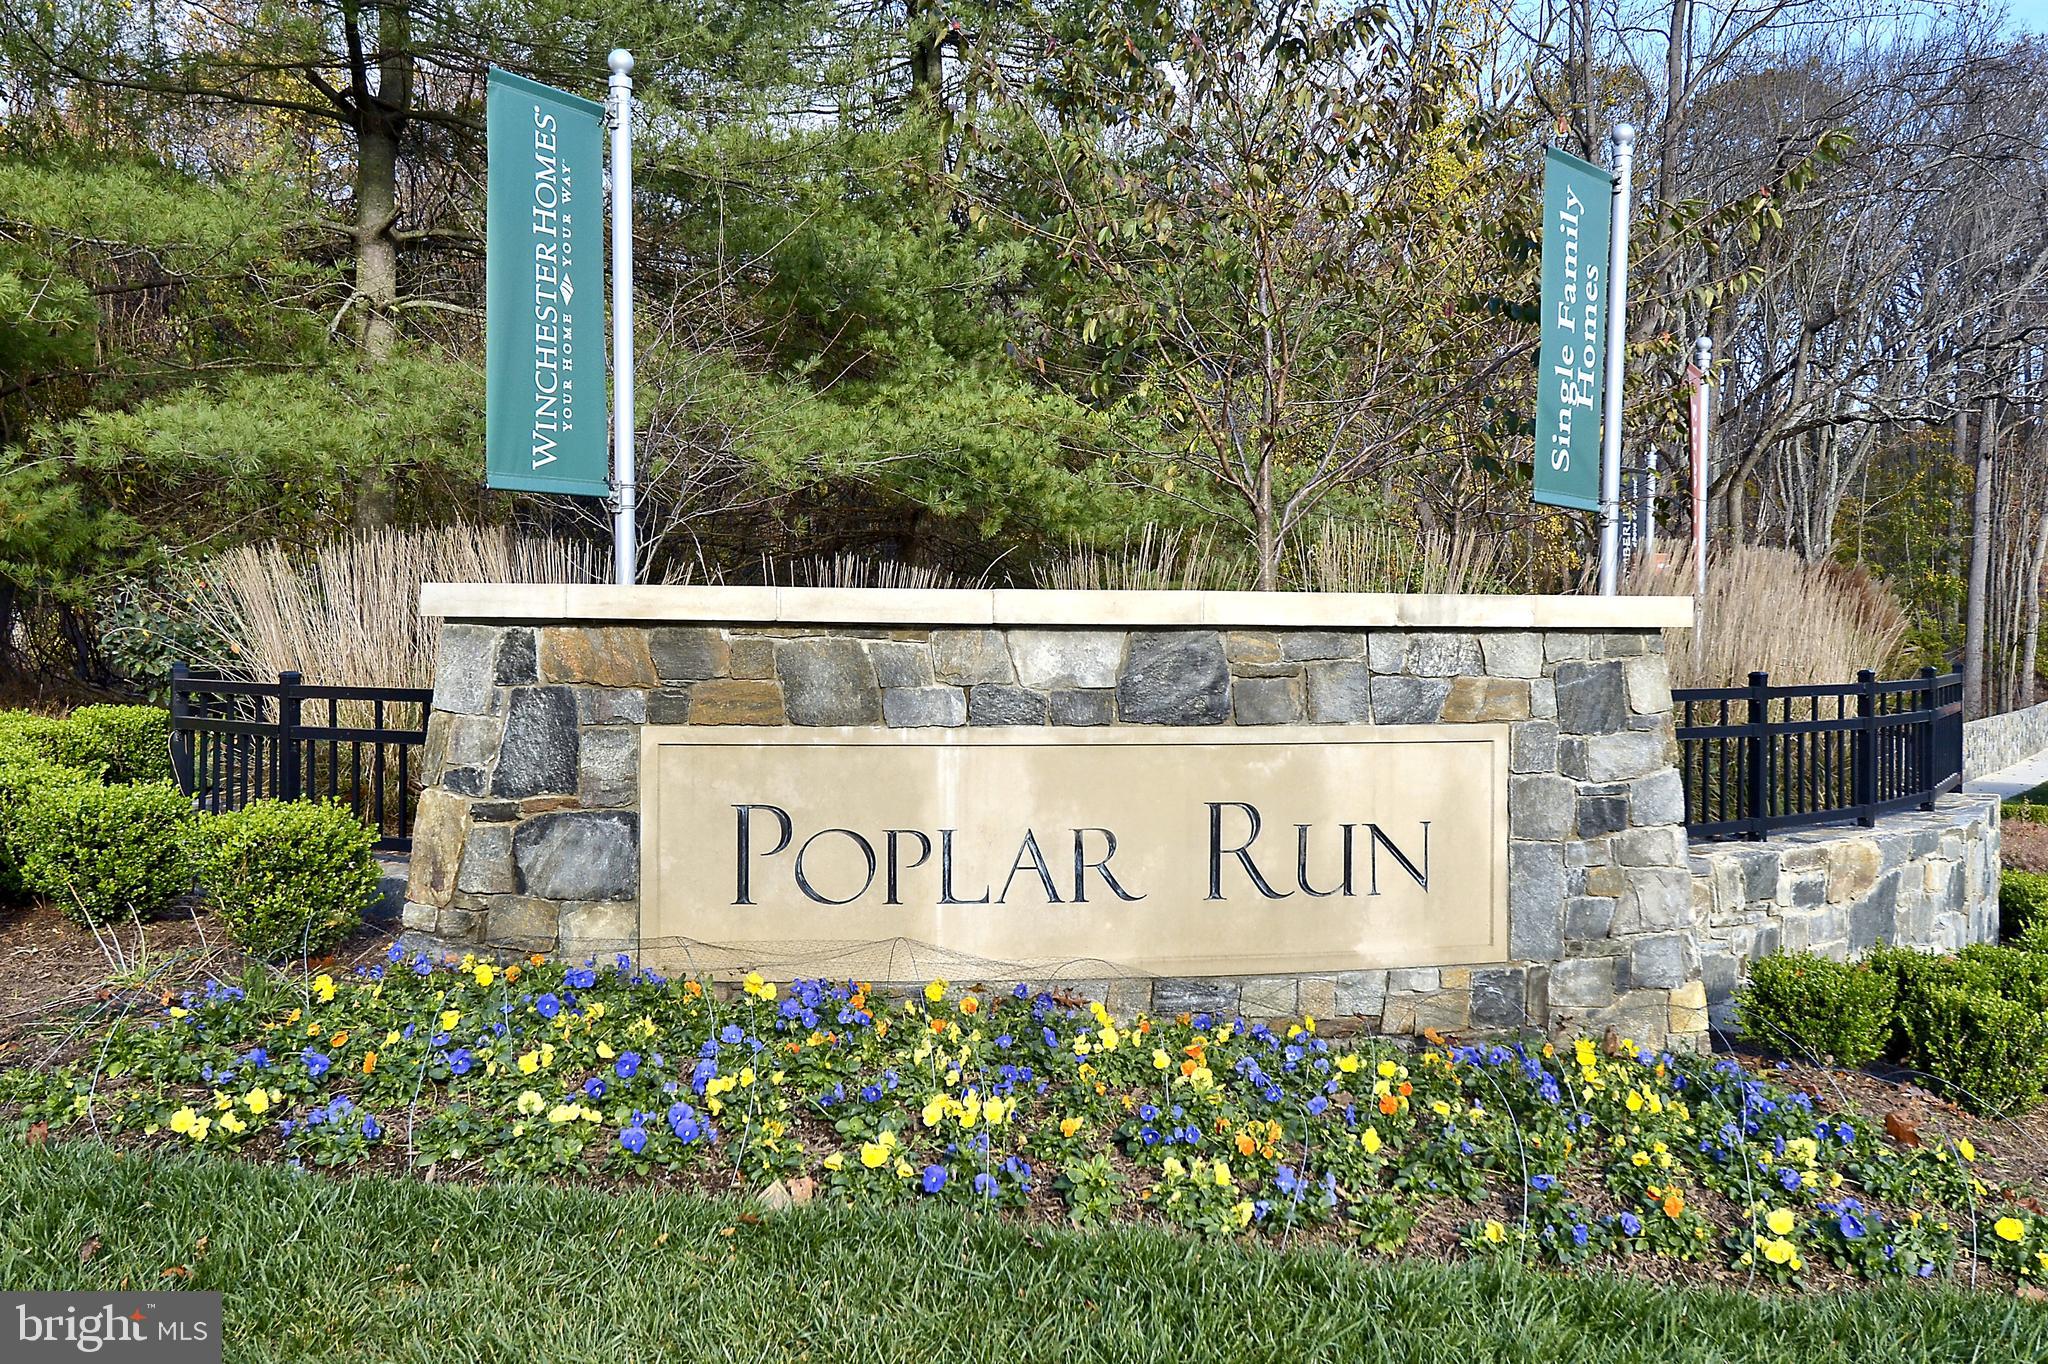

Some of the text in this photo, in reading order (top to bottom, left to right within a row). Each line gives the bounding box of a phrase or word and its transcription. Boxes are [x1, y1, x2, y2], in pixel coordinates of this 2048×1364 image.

[533, 243, 558, 471] WINCHESTER
[562, 163, 573, 432] YOUR HOME YOUR WAY
[1551, 184, 1586, 472] Single Family
[1576, 264, 1600, 412] Homes
[731, 802, 1432, 906] POPLAR RUN
